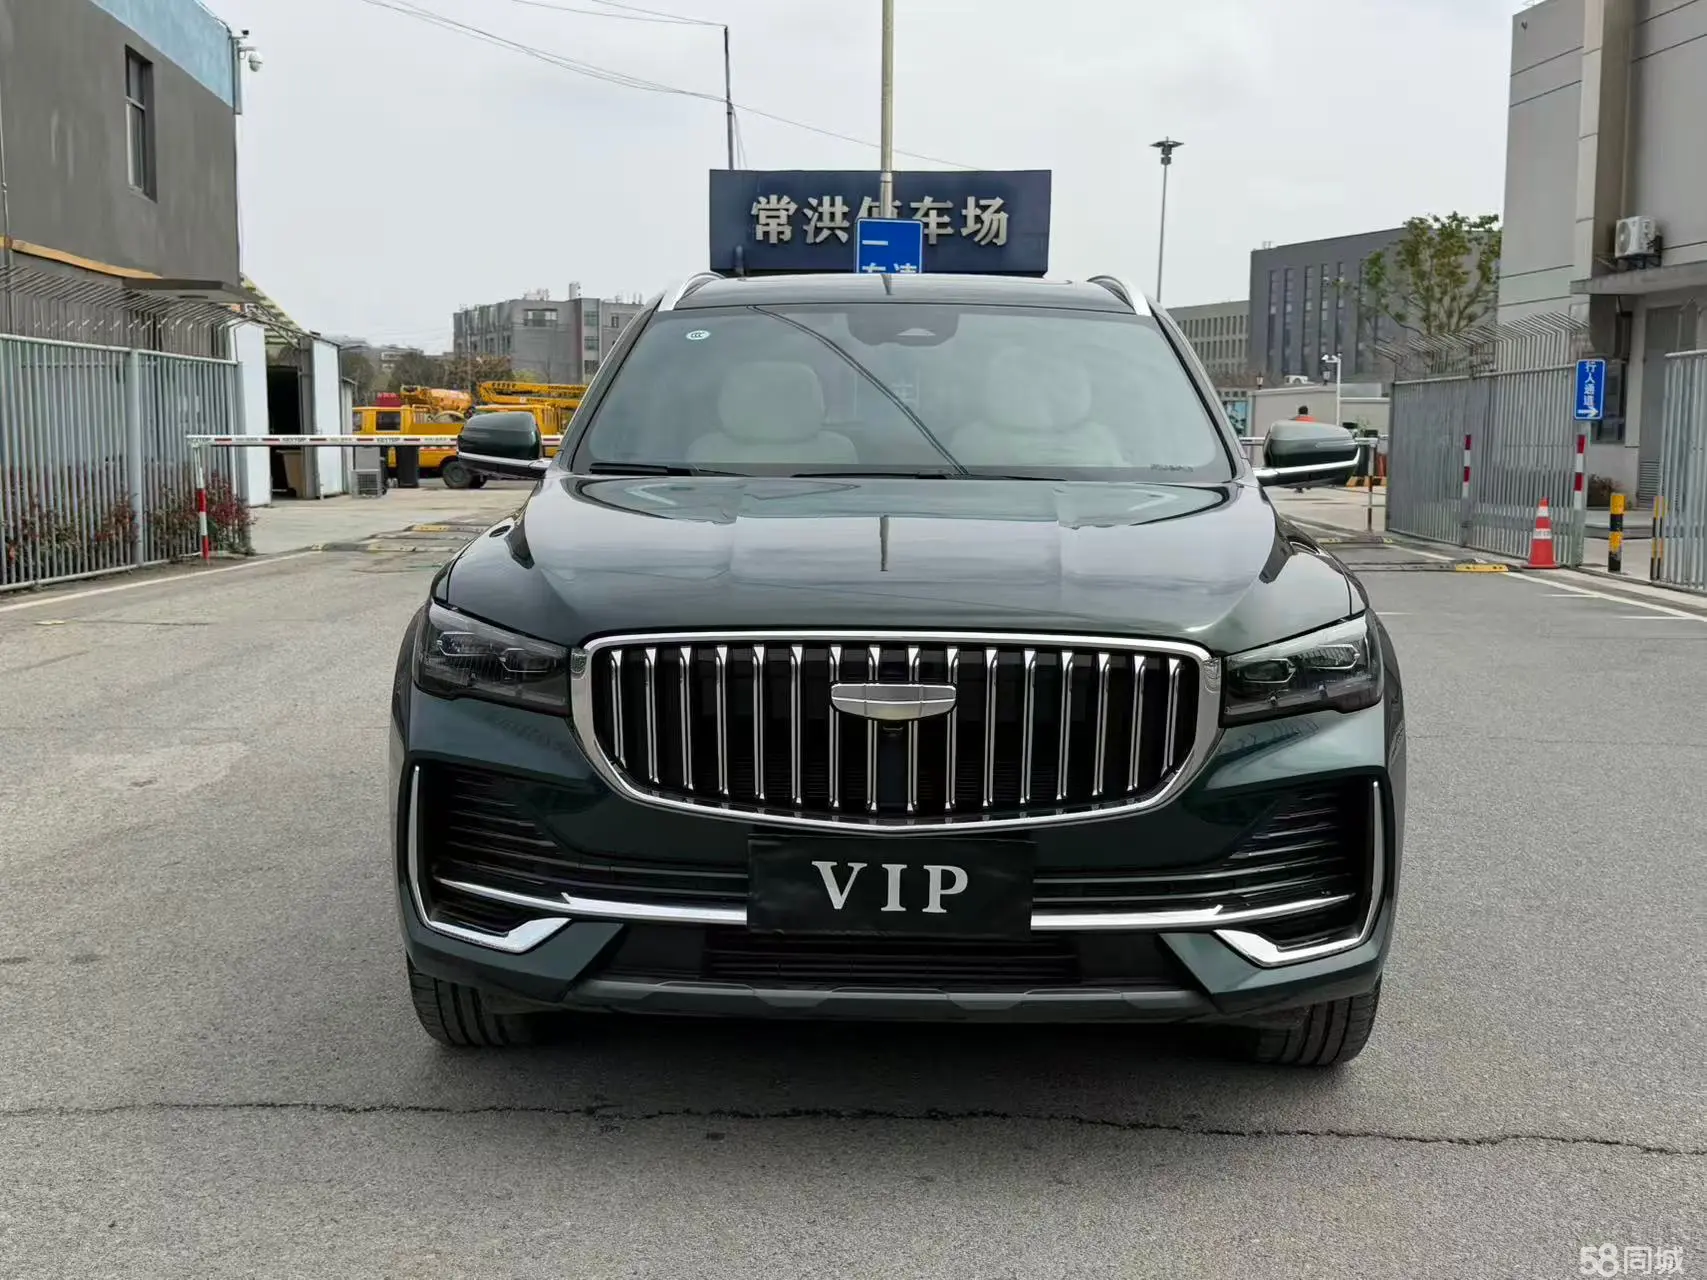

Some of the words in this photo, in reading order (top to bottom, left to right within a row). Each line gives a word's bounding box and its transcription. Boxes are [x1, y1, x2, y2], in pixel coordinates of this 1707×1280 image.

[1583, 361, 1597, 407] 行人通道
[811, 861, 969, 914] VIP
